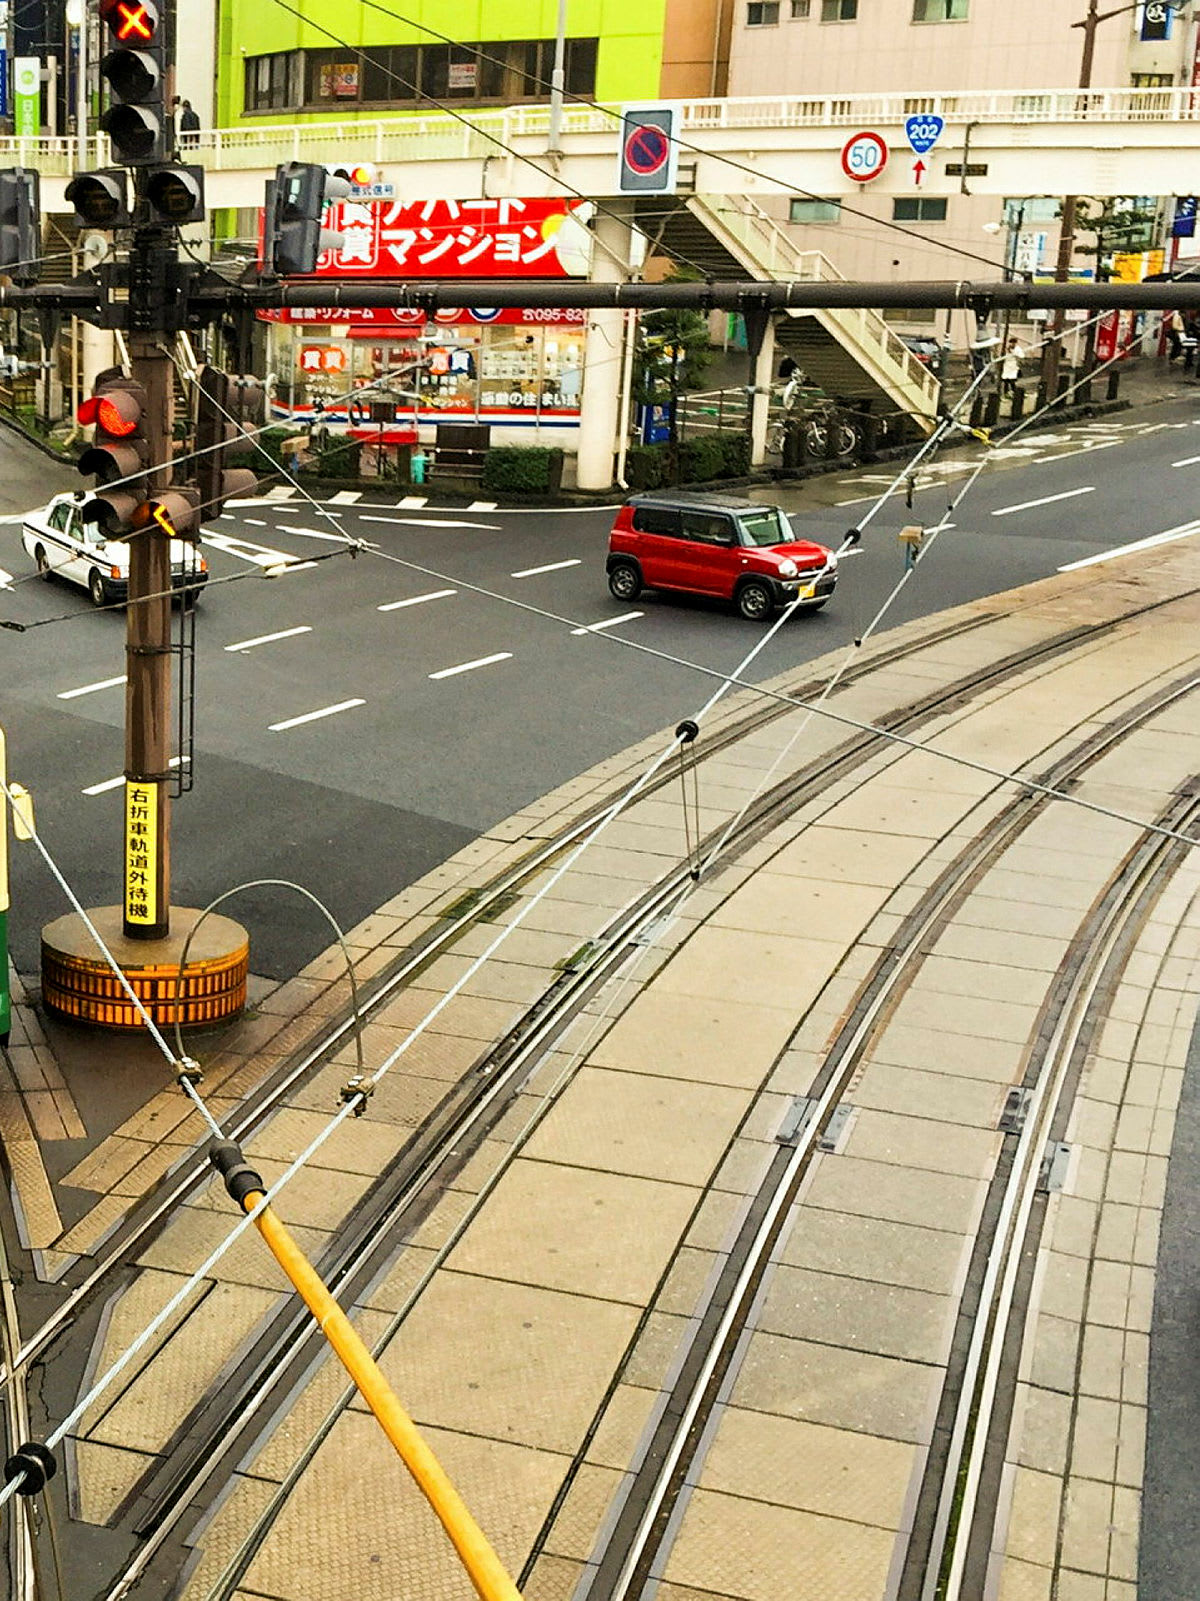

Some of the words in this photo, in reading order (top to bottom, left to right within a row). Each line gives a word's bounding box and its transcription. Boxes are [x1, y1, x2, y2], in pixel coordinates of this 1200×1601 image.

[909, 123, 938, 140] 202
[851, 145, 877, 168] 50
[381, 225, 560, 265] マンション
[129, 789, 149, 918] 右折車軌道外待機
